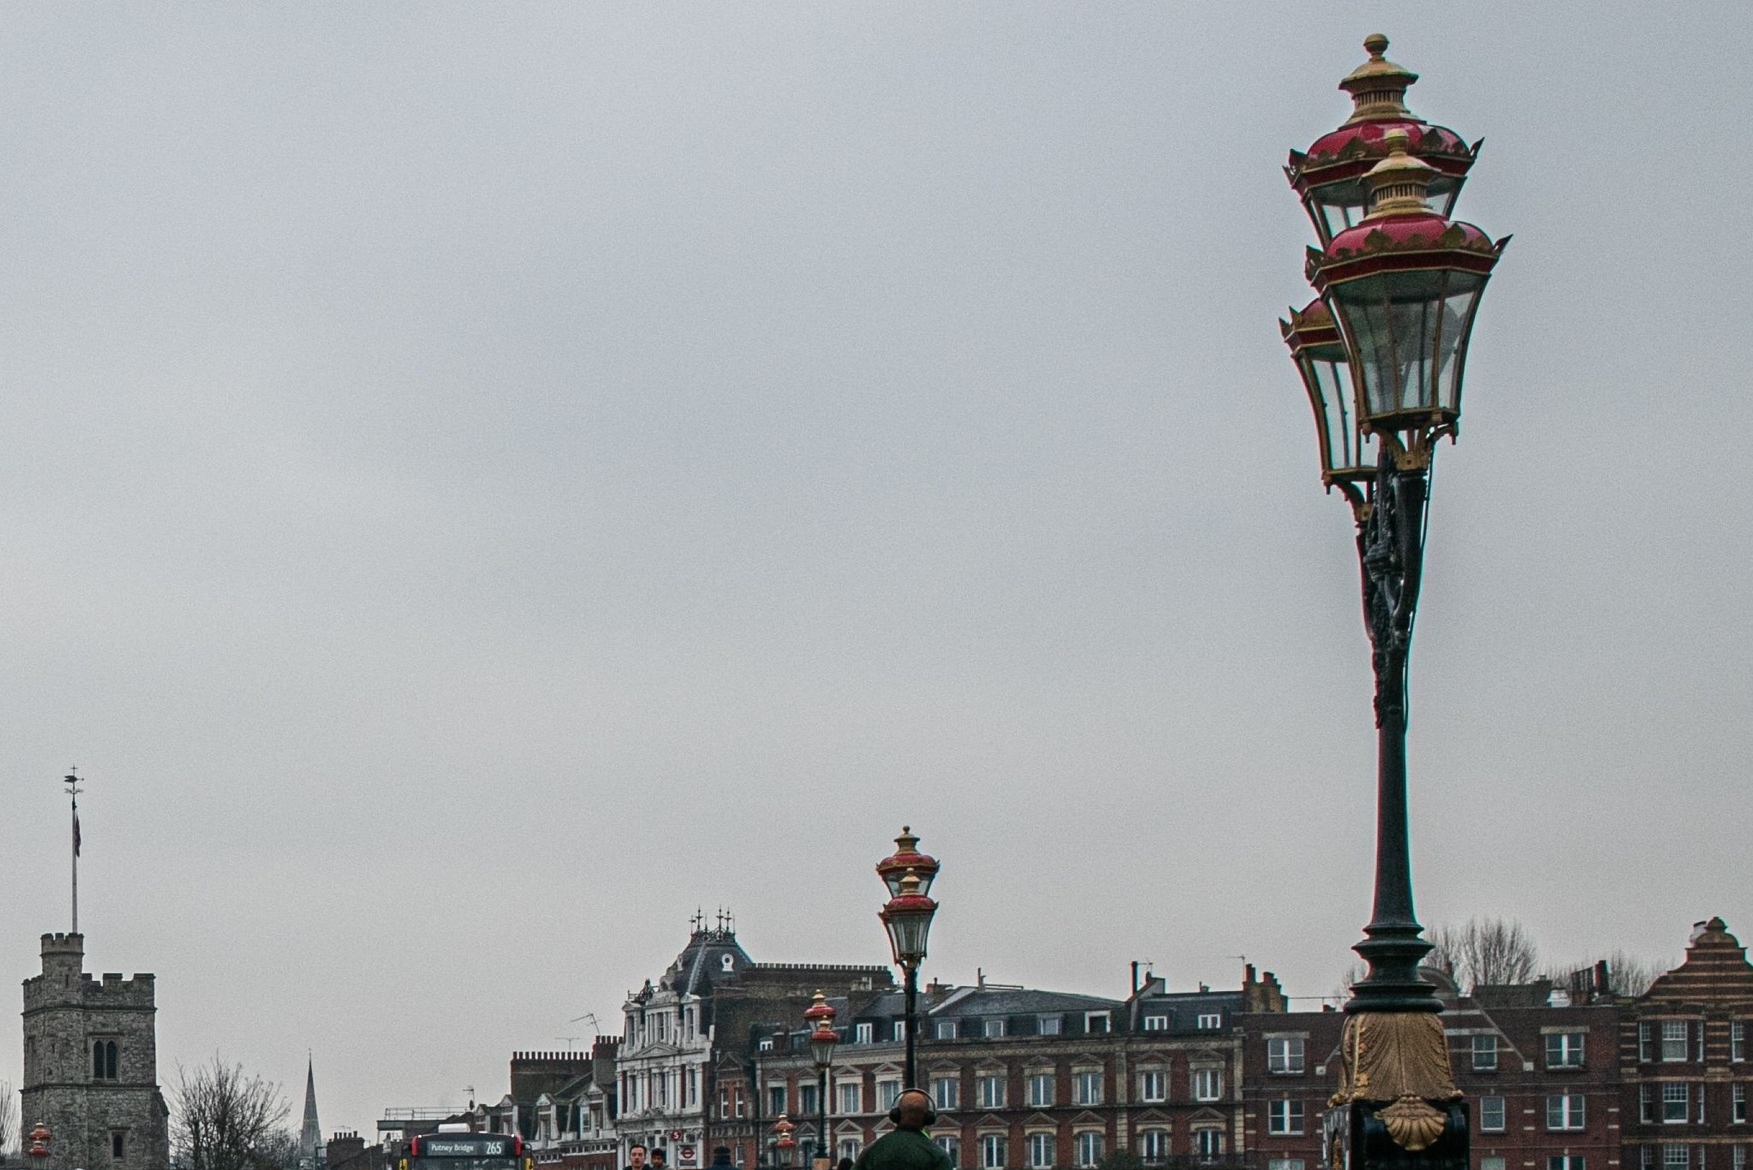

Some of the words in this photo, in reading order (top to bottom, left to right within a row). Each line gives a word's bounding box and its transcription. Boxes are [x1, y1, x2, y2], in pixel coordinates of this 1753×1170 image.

[431, 1143, 452, 1152] Putney
[454, 1143, 474, 1153] Bridge
[486, 1142, 502, 1154] 265
